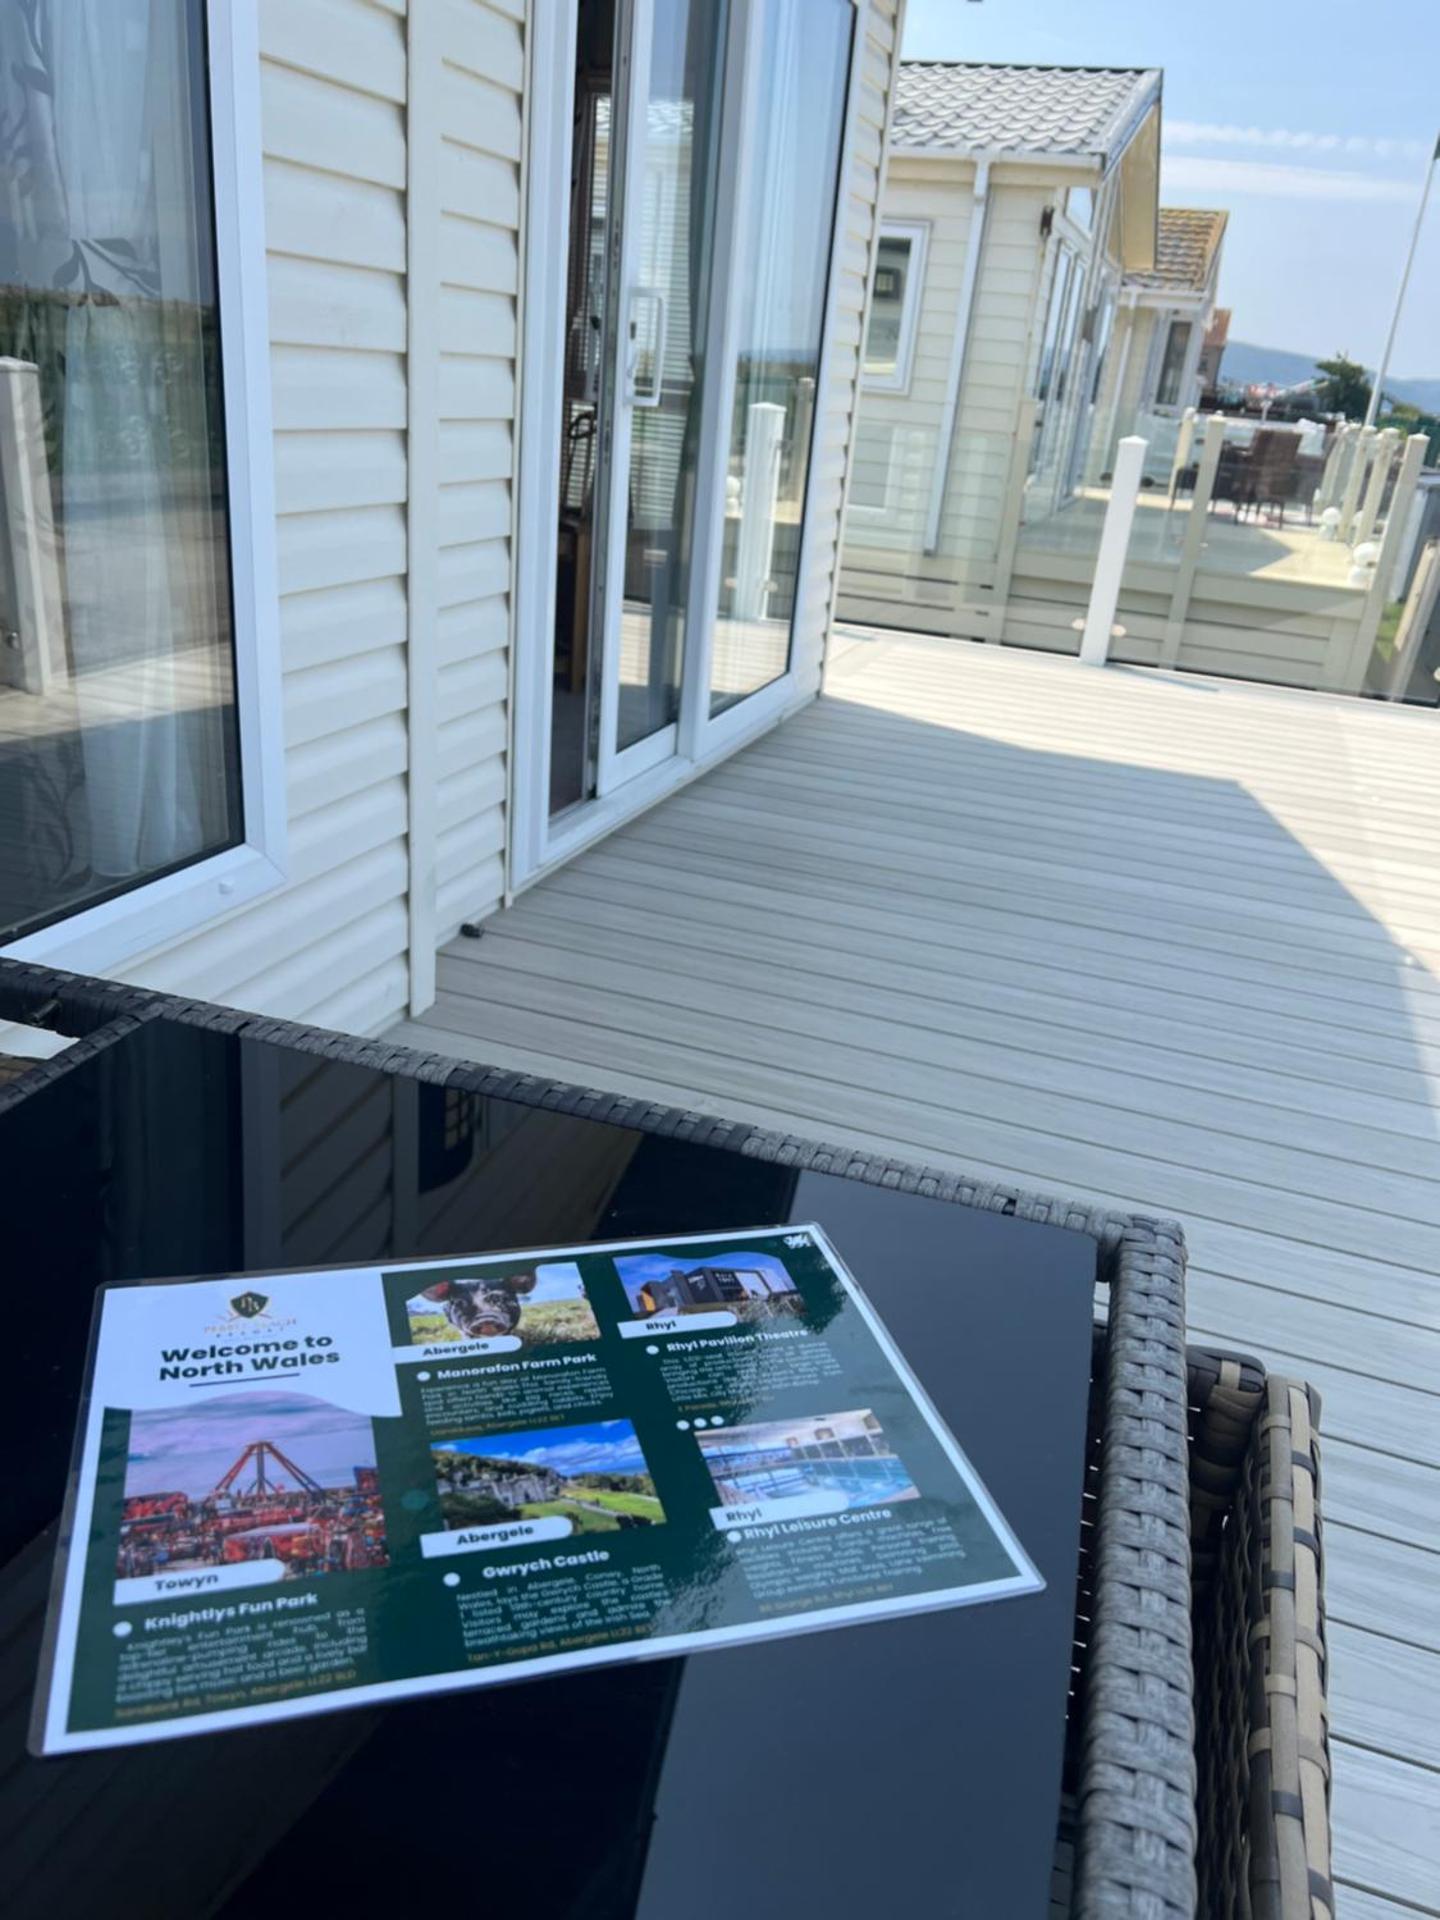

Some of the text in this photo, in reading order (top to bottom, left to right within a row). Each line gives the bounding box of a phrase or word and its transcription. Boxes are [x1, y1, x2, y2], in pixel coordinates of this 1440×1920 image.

[646, 1320, 676, 1331] Rhyl
[161, 1335, 333, 1362] Welcome to
[423, 1341, 489, 1357] Abergele
[667, 1329, 808, 1353] Rhyl Pavilion Theatre
[160, 1352, 340, 1380] North Wales
[437, 1353, 597, 1378] Manorafon Farm Park
[726, 1508, 762, 1525] Rhyl
[744, 1508, 892, 1541] Rhyl Leisure Centre
[457, 1525, 534, 1546] Abergele
[482, 1549, 610, 1579] Gwrych Castle
[155, 1573, 219, 1591] Towyn
[145, 1592, 318, 1630] Knightlys Fun Park
